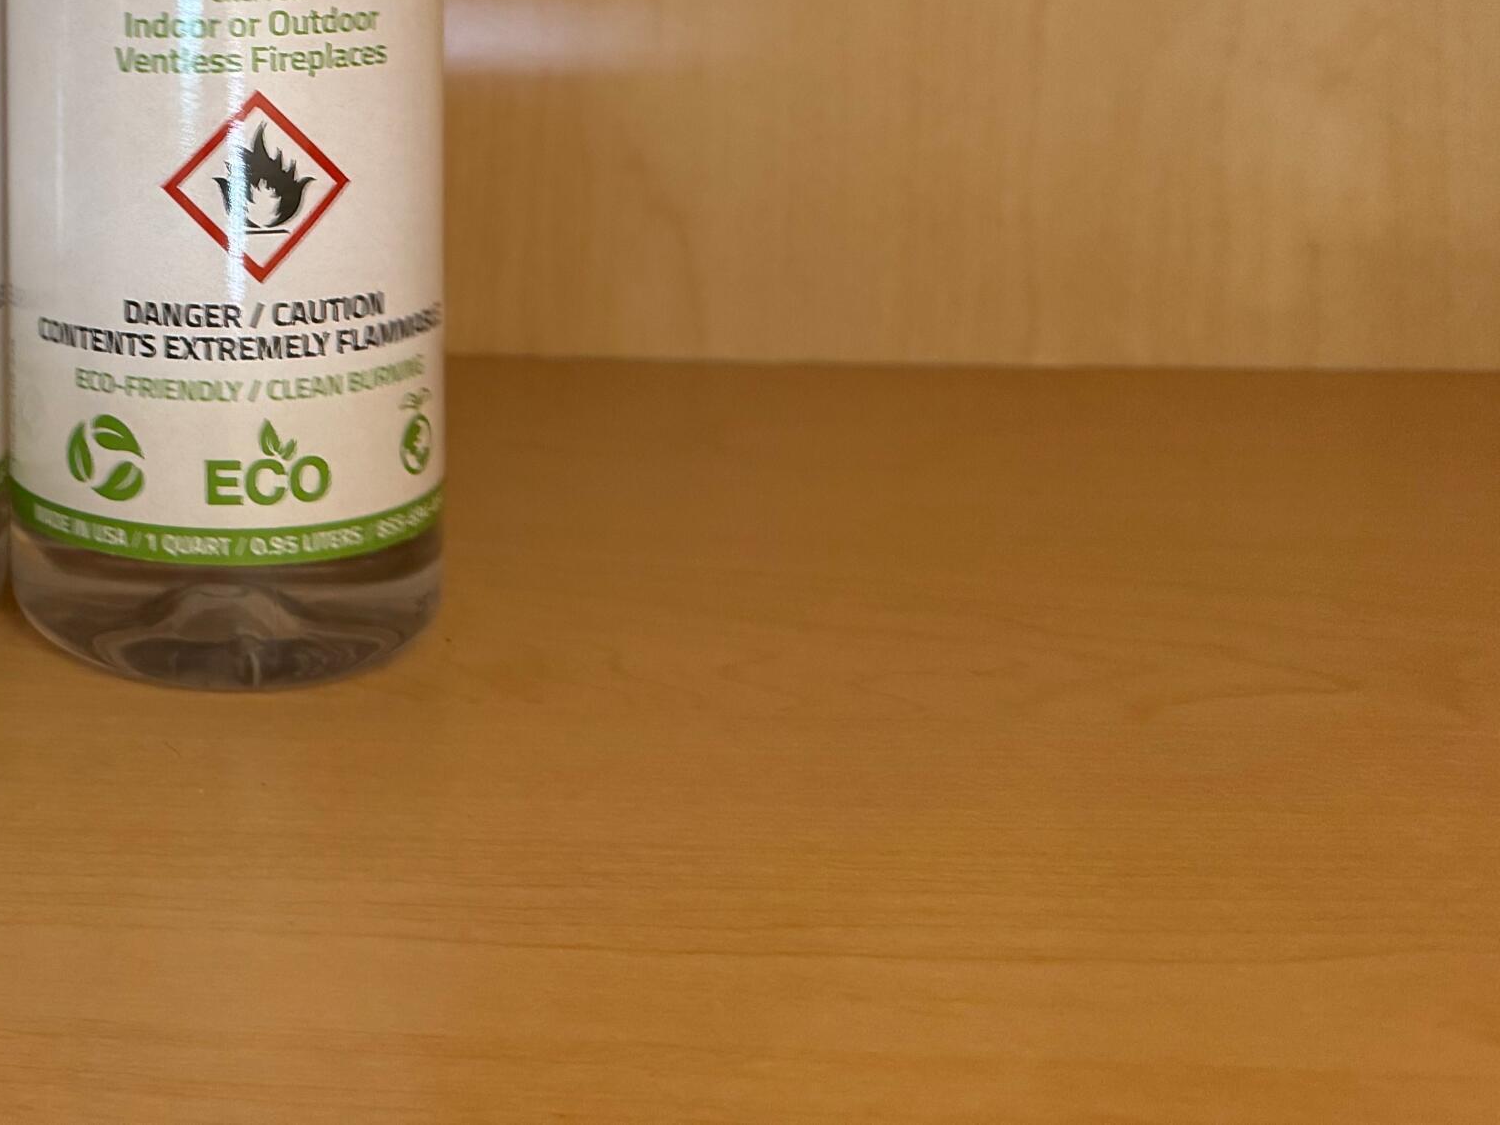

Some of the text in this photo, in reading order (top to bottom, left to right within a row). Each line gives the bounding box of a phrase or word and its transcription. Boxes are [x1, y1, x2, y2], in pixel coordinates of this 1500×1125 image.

[124, 7, 380, 40] Indoor or Outdoor
[114, 41, 388, 77] Ventless Fireplaces
[124, 299, 241, 329] DANGER
[272, 291, 384, 325] CAUTION
[37, 317, 157, 358] CONTENTS
[163, 331, 331, 362] EXTREMELY
[75, 367, 240, 402] ECO-FRIENDLY
[266, 374, 344, 401] CLEAN
[204, 455, 332, 506] ECO
[145, 533, 157, 552] 1
[161, 534, 231, 556] QUART
[302, 526, 364, 554] LITERS
